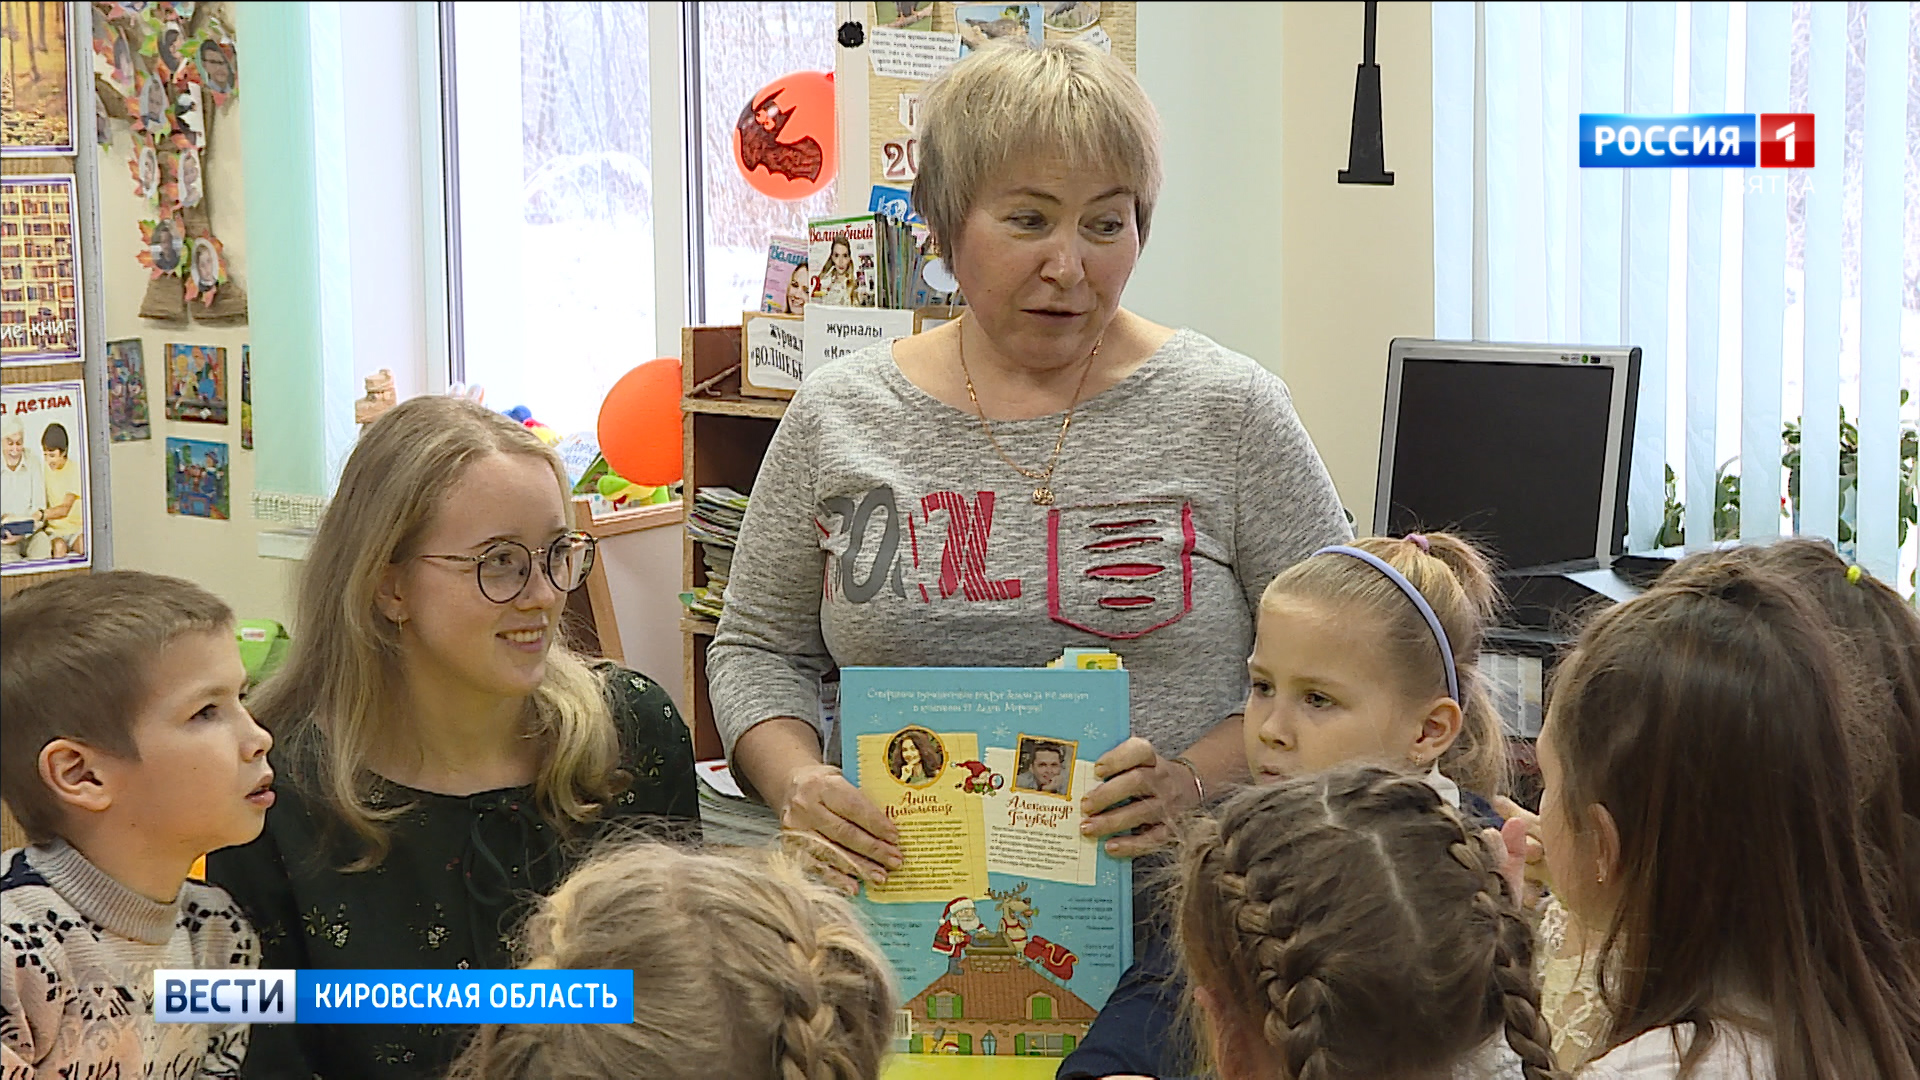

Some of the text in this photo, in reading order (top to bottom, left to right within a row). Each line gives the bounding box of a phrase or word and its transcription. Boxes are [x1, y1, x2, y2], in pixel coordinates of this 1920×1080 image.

[31, 318, 75, 336] книг
[826, 323, 882, 340] журналы
[15, 395, 71, 415] детям
[898, 791, 938, 806] Анна
